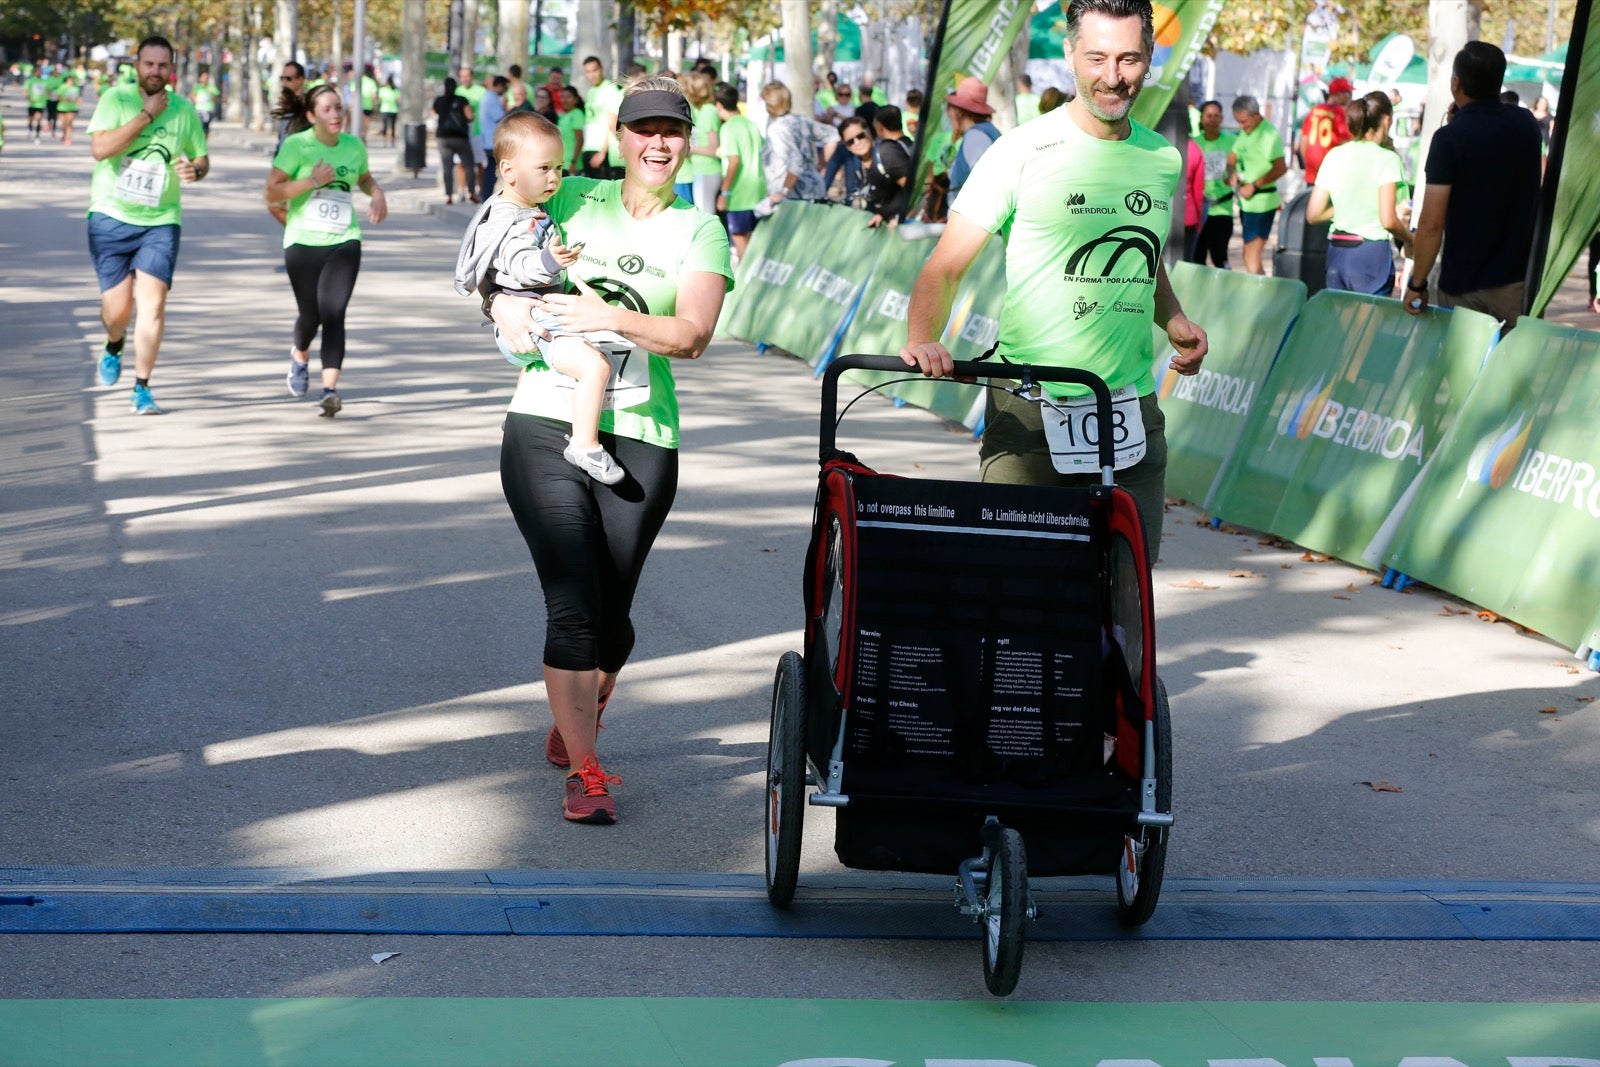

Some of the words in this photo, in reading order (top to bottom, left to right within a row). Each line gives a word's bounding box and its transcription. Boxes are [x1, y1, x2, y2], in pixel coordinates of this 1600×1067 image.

[1309, 116, 1333, 148] 10
[125, 173, 153, 193] 114
[318, 202, 340, 220] 98
[1071, 207, 1117, 215] IBERDROLA
[1075, 276, 1102, 284] FORMA
[1172, 369, 1255, 416] IBERDROLA
[1059, 410, 1129, 447] 108
[866, 502, 879, 513] not
[880, 505, 912, 517] overpass
[914, 504, 927, 516] this
[981, 508, 993, 521] Die
[995, 509, 1028, 523] Limitlinie
[1028, 511, 1046, 524] nicht
